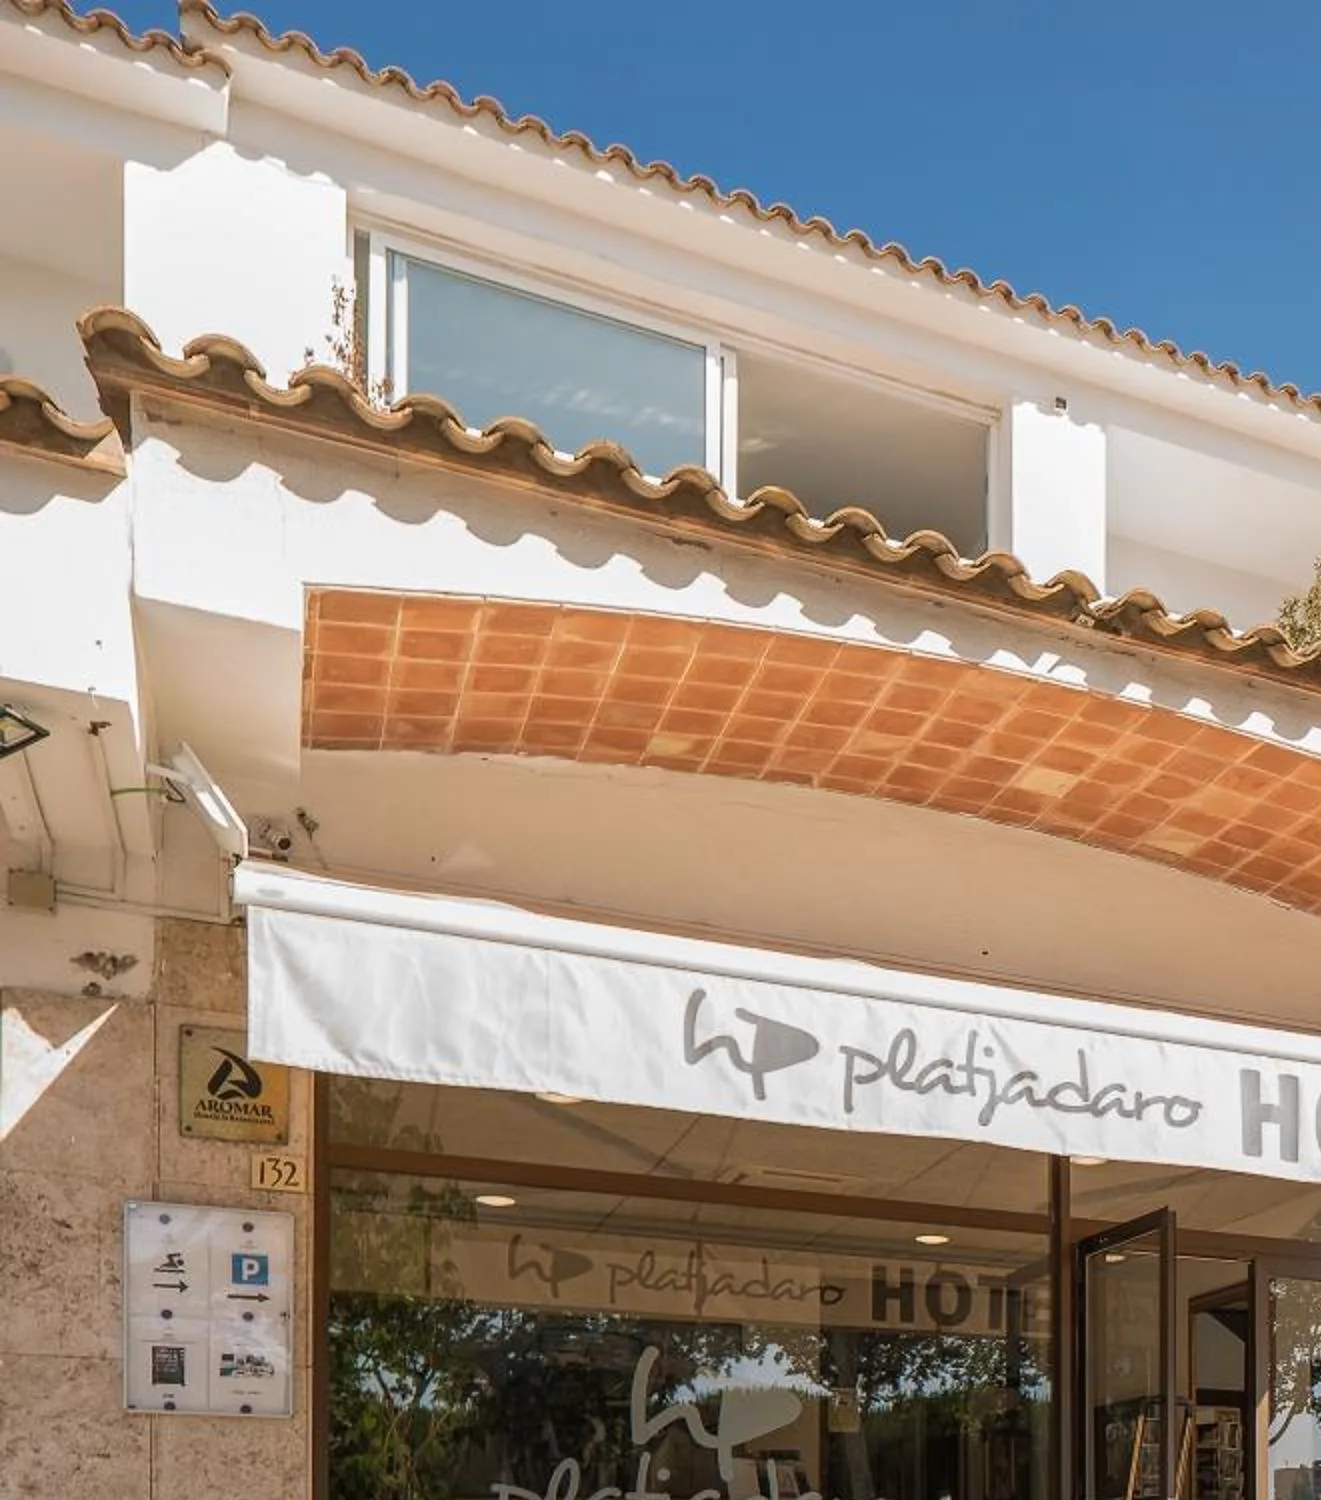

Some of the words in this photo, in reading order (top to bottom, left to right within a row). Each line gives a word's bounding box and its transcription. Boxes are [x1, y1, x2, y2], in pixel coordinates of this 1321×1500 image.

[839, 1028, 1203, 1127] platjadaro
[195, 1099, 274, 1119] AROMAR
[260, 1158, 299, 1187] 132
